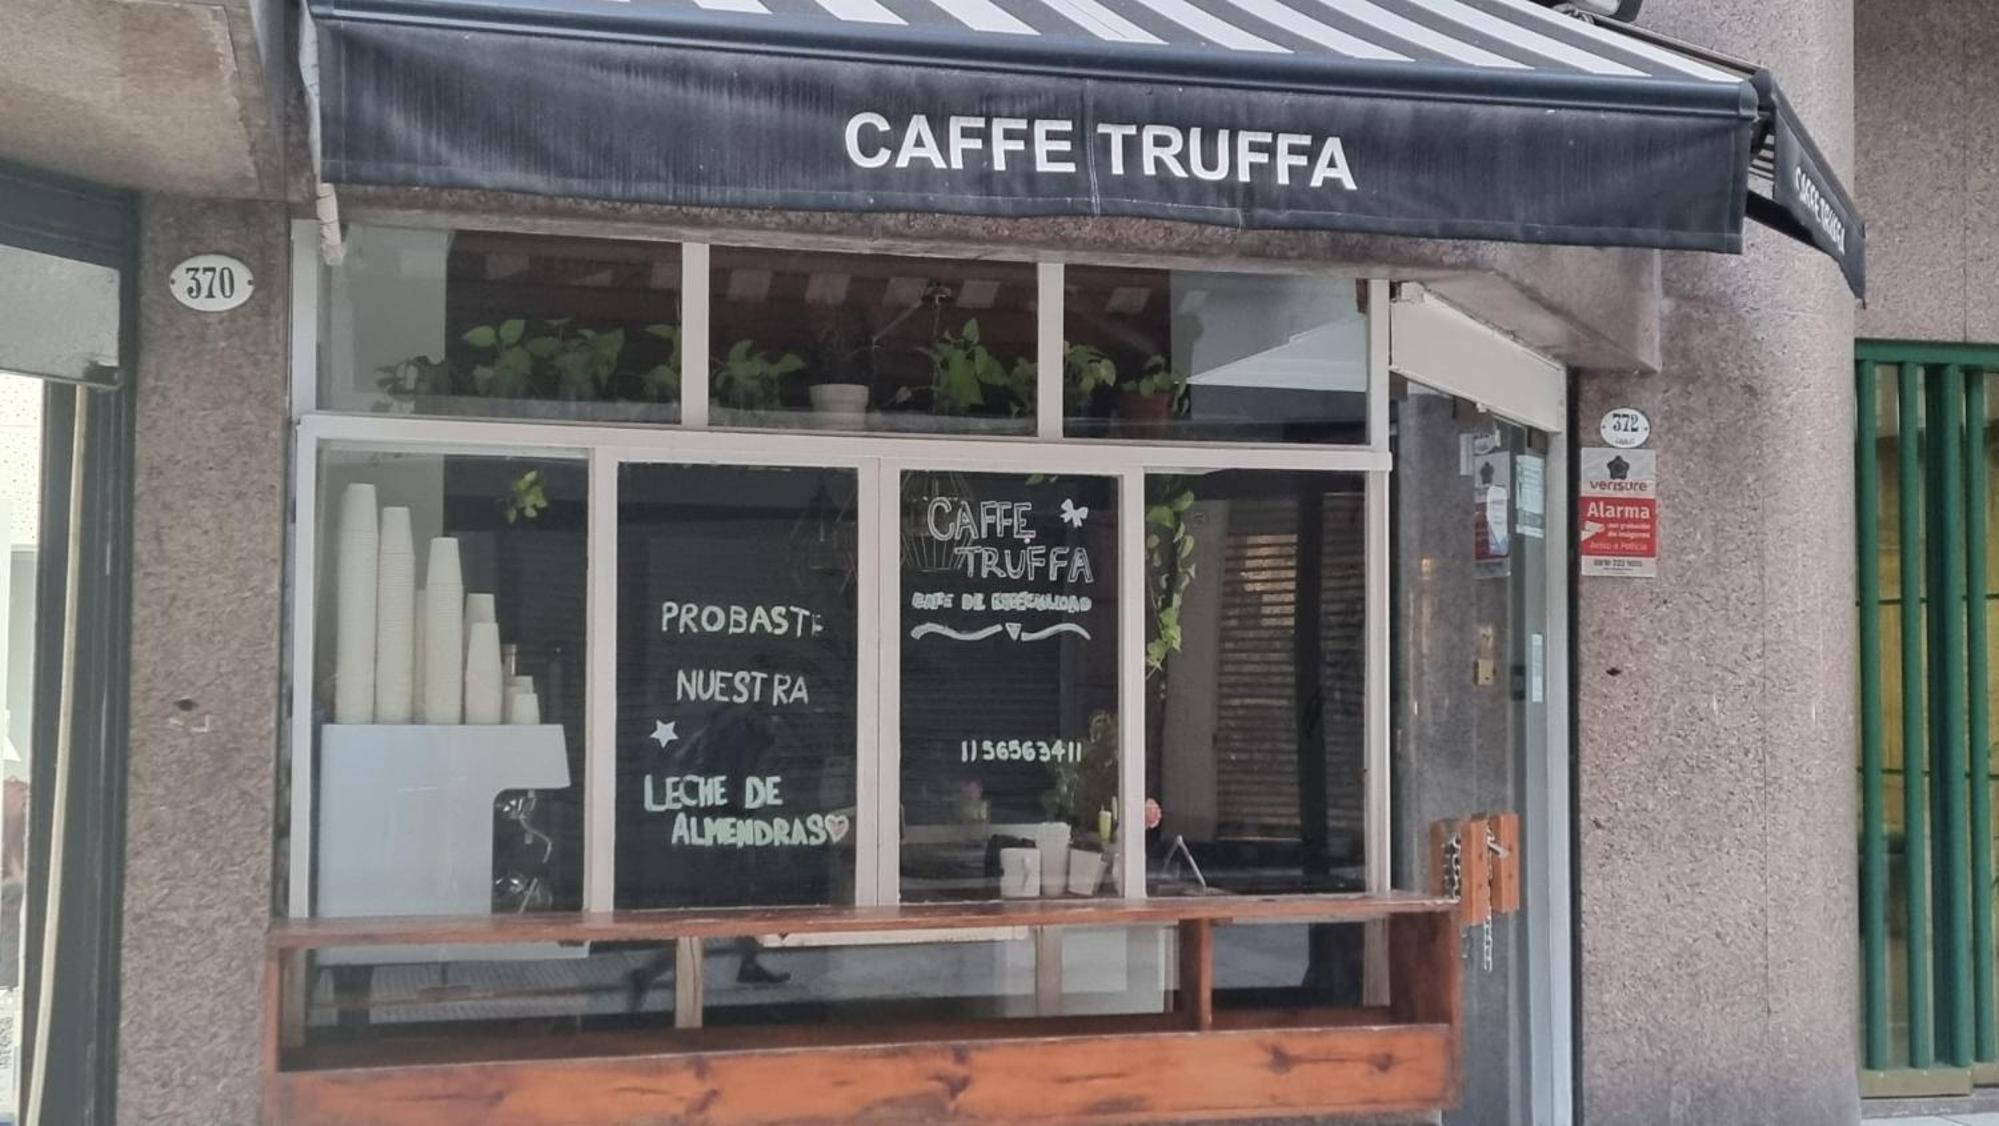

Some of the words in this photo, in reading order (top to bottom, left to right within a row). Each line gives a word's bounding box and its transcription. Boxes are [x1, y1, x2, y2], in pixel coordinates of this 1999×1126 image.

[844, 111, 1077, 174] CAFFE
[1097, 122, 1358, 191] TRUFFA
[185, 266, 235, 299] 370
[1612, 413, 1639, 432] 372
[1590, 480, 1648, 492] verisure
[927, 496, 1036, 541] CAFFE
[1587, 501, 1650, 519] Alarma
[954, 545, 1094, 584] TRUFFA
[961, 593, 986, 611] DE
[676, 669, 809, 706] NUESTRA
[644, 774, 728, 812] LECHE
[744, 776, 784, 809] DE
[671, 812, 827, 848] ALMENDRAS
